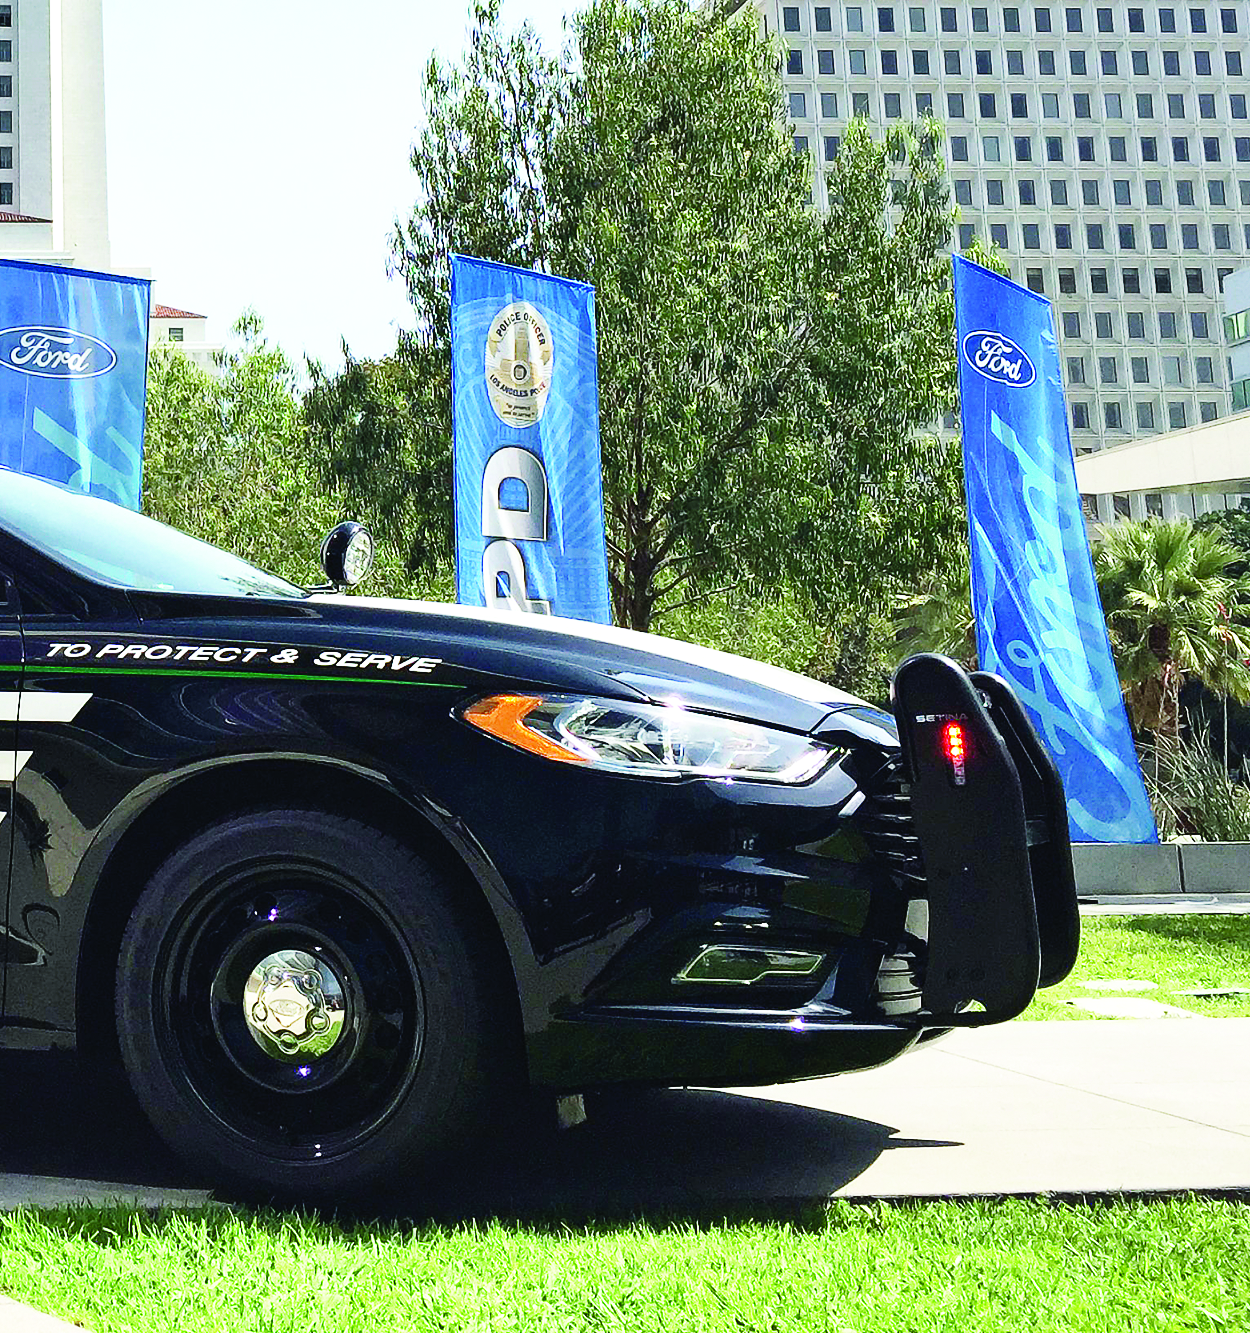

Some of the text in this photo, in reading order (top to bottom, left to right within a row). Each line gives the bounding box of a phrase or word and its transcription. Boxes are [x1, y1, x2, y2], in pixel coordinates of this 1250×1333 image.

[496, 312, 521, 337] POLICE
[10, 332, 93, 372] Ford
[975, 336, 1022, 380] Ford
[490, 374, 501, 387] LOS
[500, 383, 528, 397] ANGELES
[46, 643, 443, 673] TO PROTECT & SERVE
[915, 713, 968, 722] SETINA
